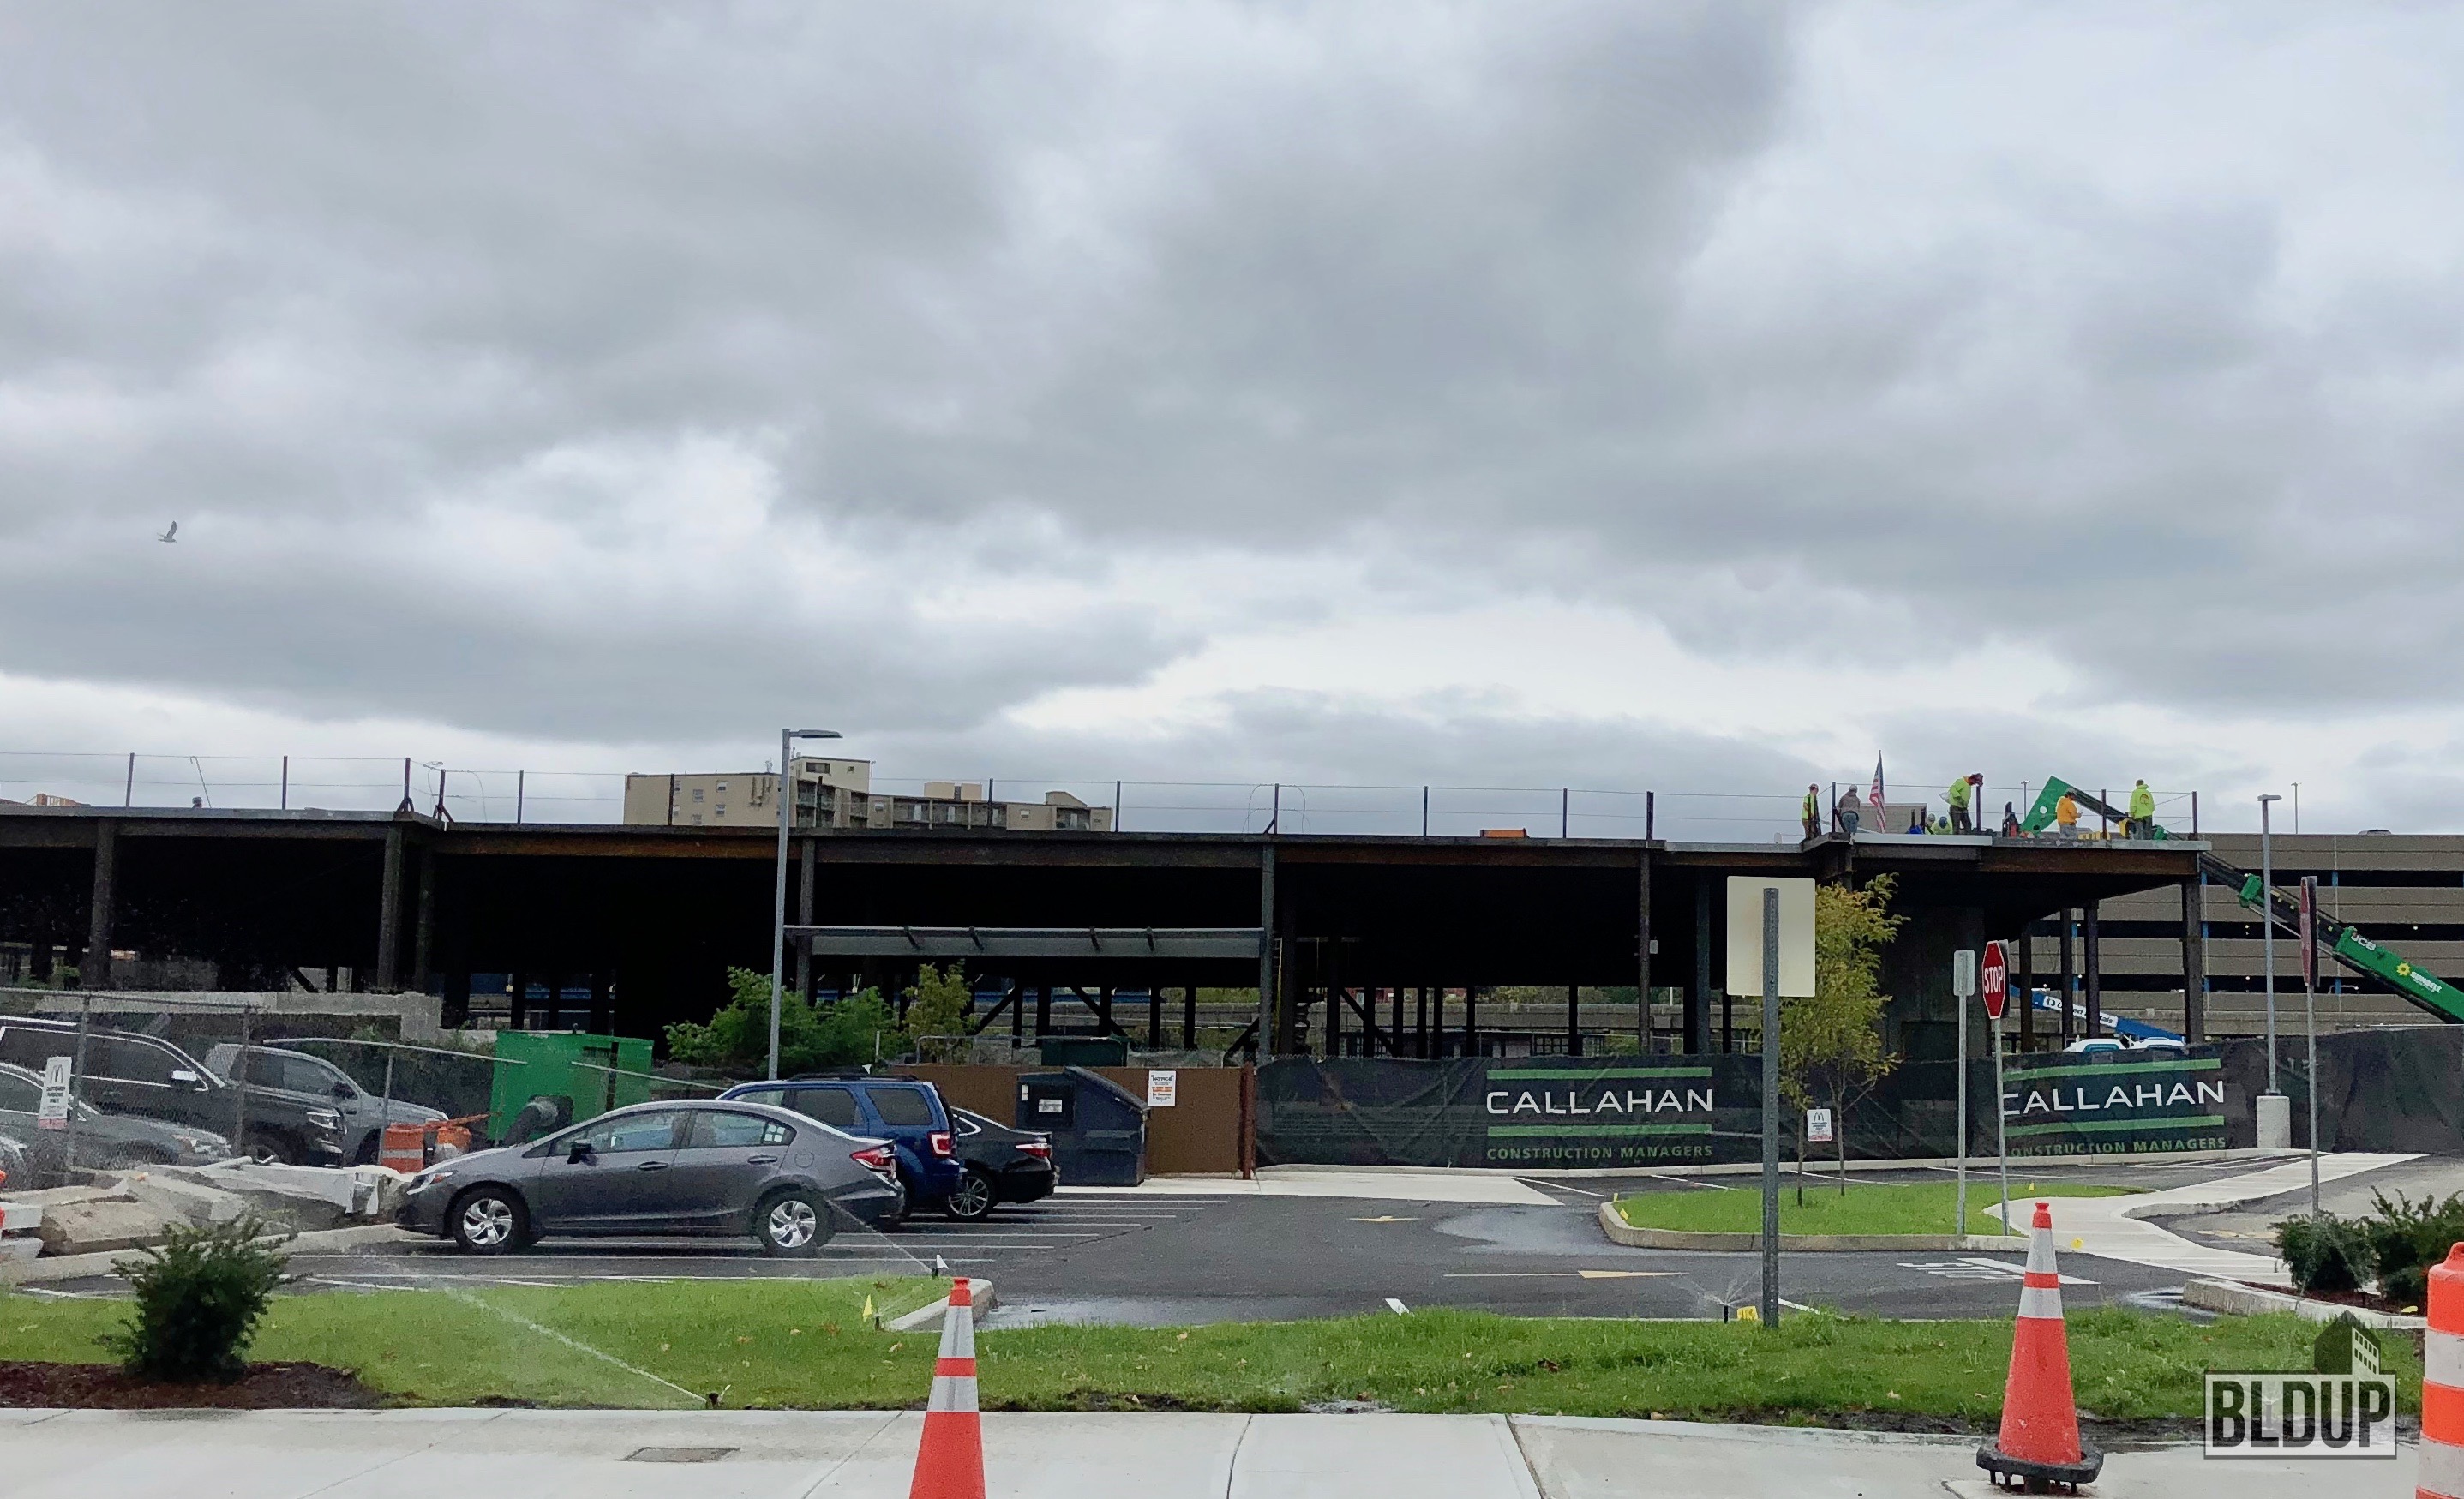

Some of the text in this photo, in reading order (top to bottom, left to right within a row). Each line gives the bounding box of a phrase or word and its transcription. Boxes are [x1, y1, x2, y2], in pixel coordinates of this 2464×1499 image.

[2351, 934, 2376, 951] JCB
[1984, 965, 2003, 994] STOP
[1486, 1089, 1712, 1114] CALLAHAN
[2002, 1080, 2224, 1115] CALLAHAN
[1486, 1145, 1712, 1160] CONSTRUCTION MANAGERS
[2004, 1137, 2226, 1158] ONSTRUCTION MANAGERS
